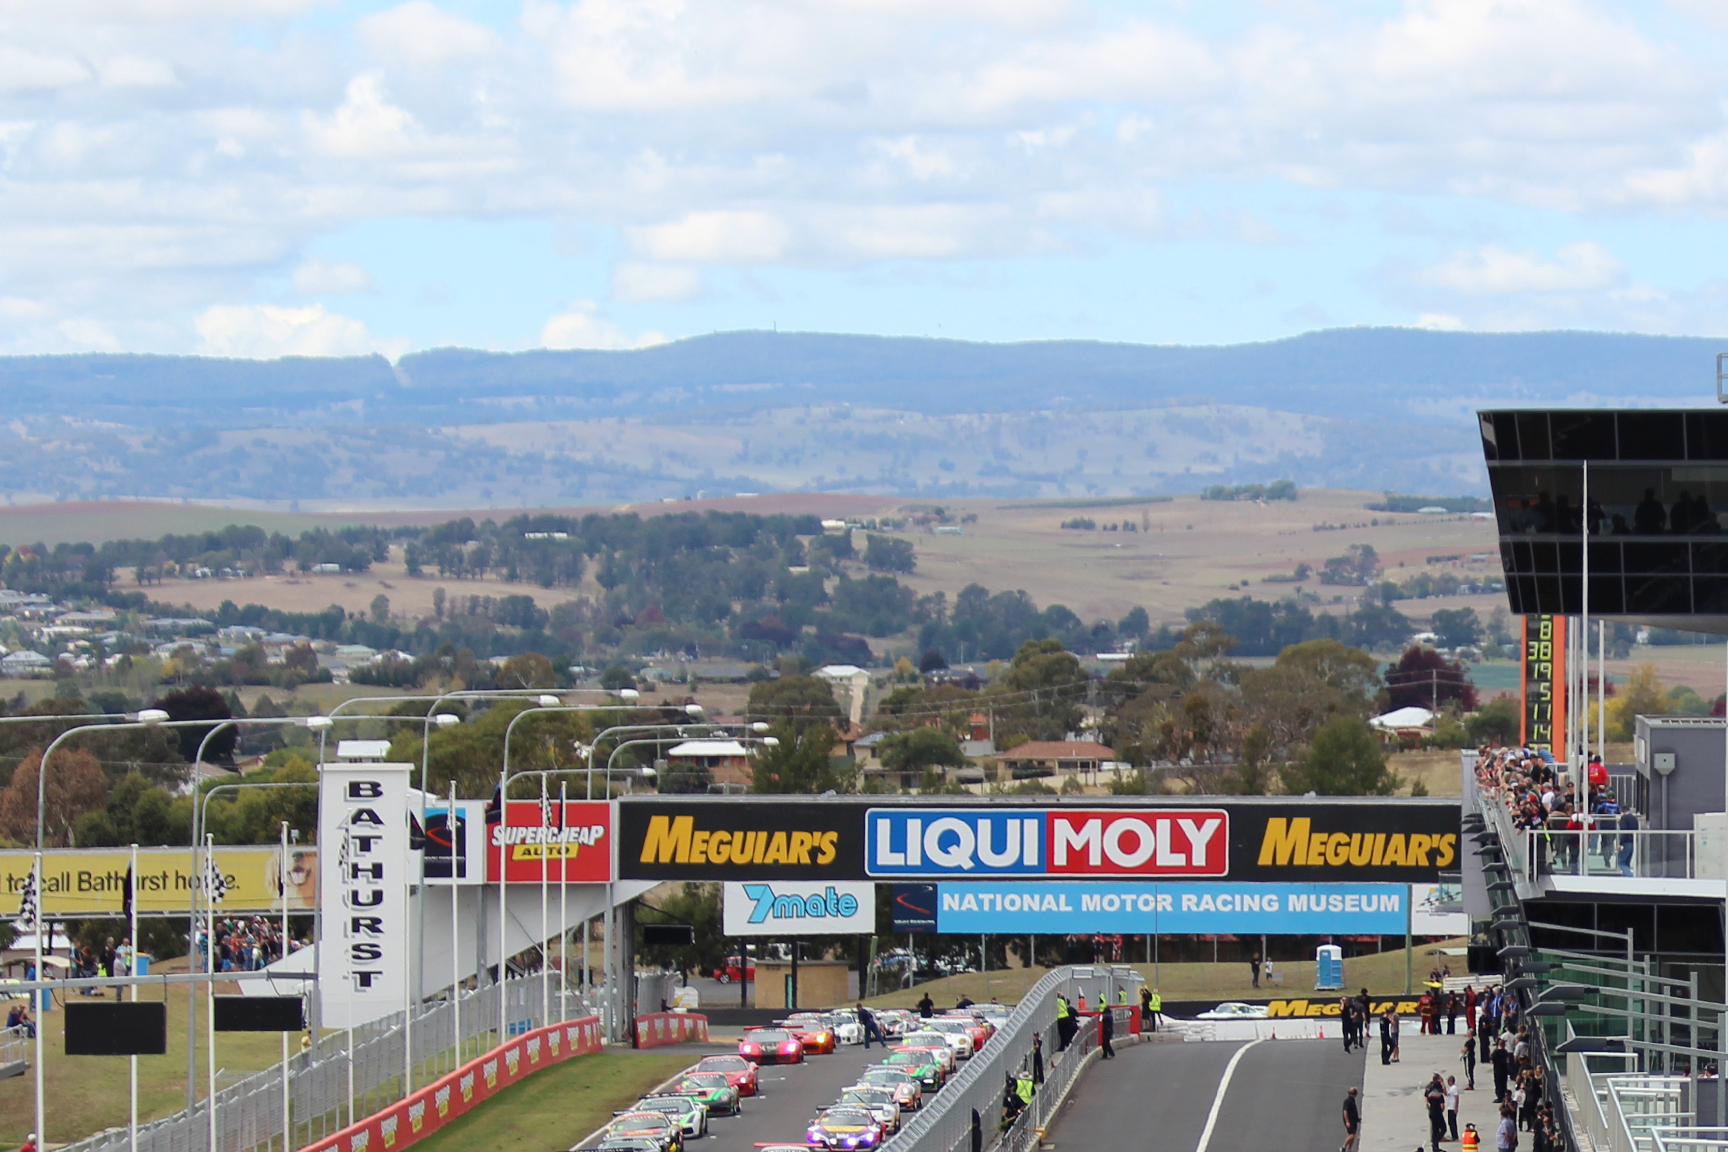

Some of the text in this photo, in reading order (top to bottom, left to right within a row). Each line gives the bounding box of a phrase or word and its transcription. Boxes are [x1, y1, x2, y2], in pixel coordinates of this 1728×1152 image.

[1540, 621, 1552, 640] 8
[1528, 641, 1552, 660] 38
[1534, 662, 1552, 680] 19
[1541, 682, 1552, 701] 5
[1533, 703, 1552, 720] 11
[1533, 724, 1552, 741] 14
[641, 816, 838, 864] MEGUIAR'S
[877, 818, 1222, 869] LIQUI MOLY
[1258, 818, 1456, 866] MEGUIAR'S
[349, 781, 384, 987] BATHURST
[742, 884, 858, 923] 7mate
[943, 893, 1400, 912] NATIONAL MOTOR RACING MUSEUM
